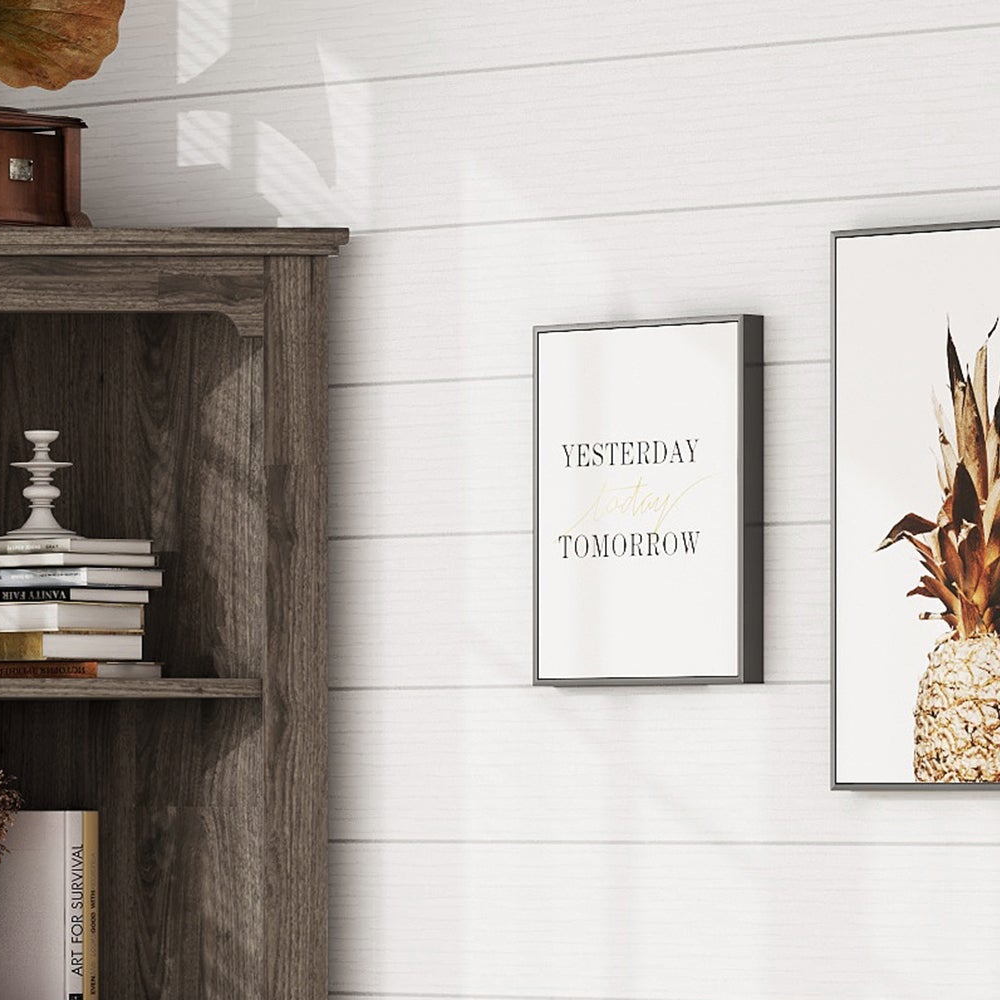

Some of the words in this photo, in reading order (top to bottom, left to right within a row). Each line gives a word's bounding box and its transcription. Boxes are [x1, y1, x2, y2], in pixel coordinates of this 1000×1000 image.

[561, 439, 700, 468] YESTERDAY
[557, 475, 712, 537] today
[558, 531, 700, 558] TOMORROW
[1, 590, 26, 600] FAIR
[28, 590, 67, 600] VANITY
[71, 843, 83, 909] SURVIVAL
[71, 915, 83, 944] FOR
[71, 950, 83, 977] ART
